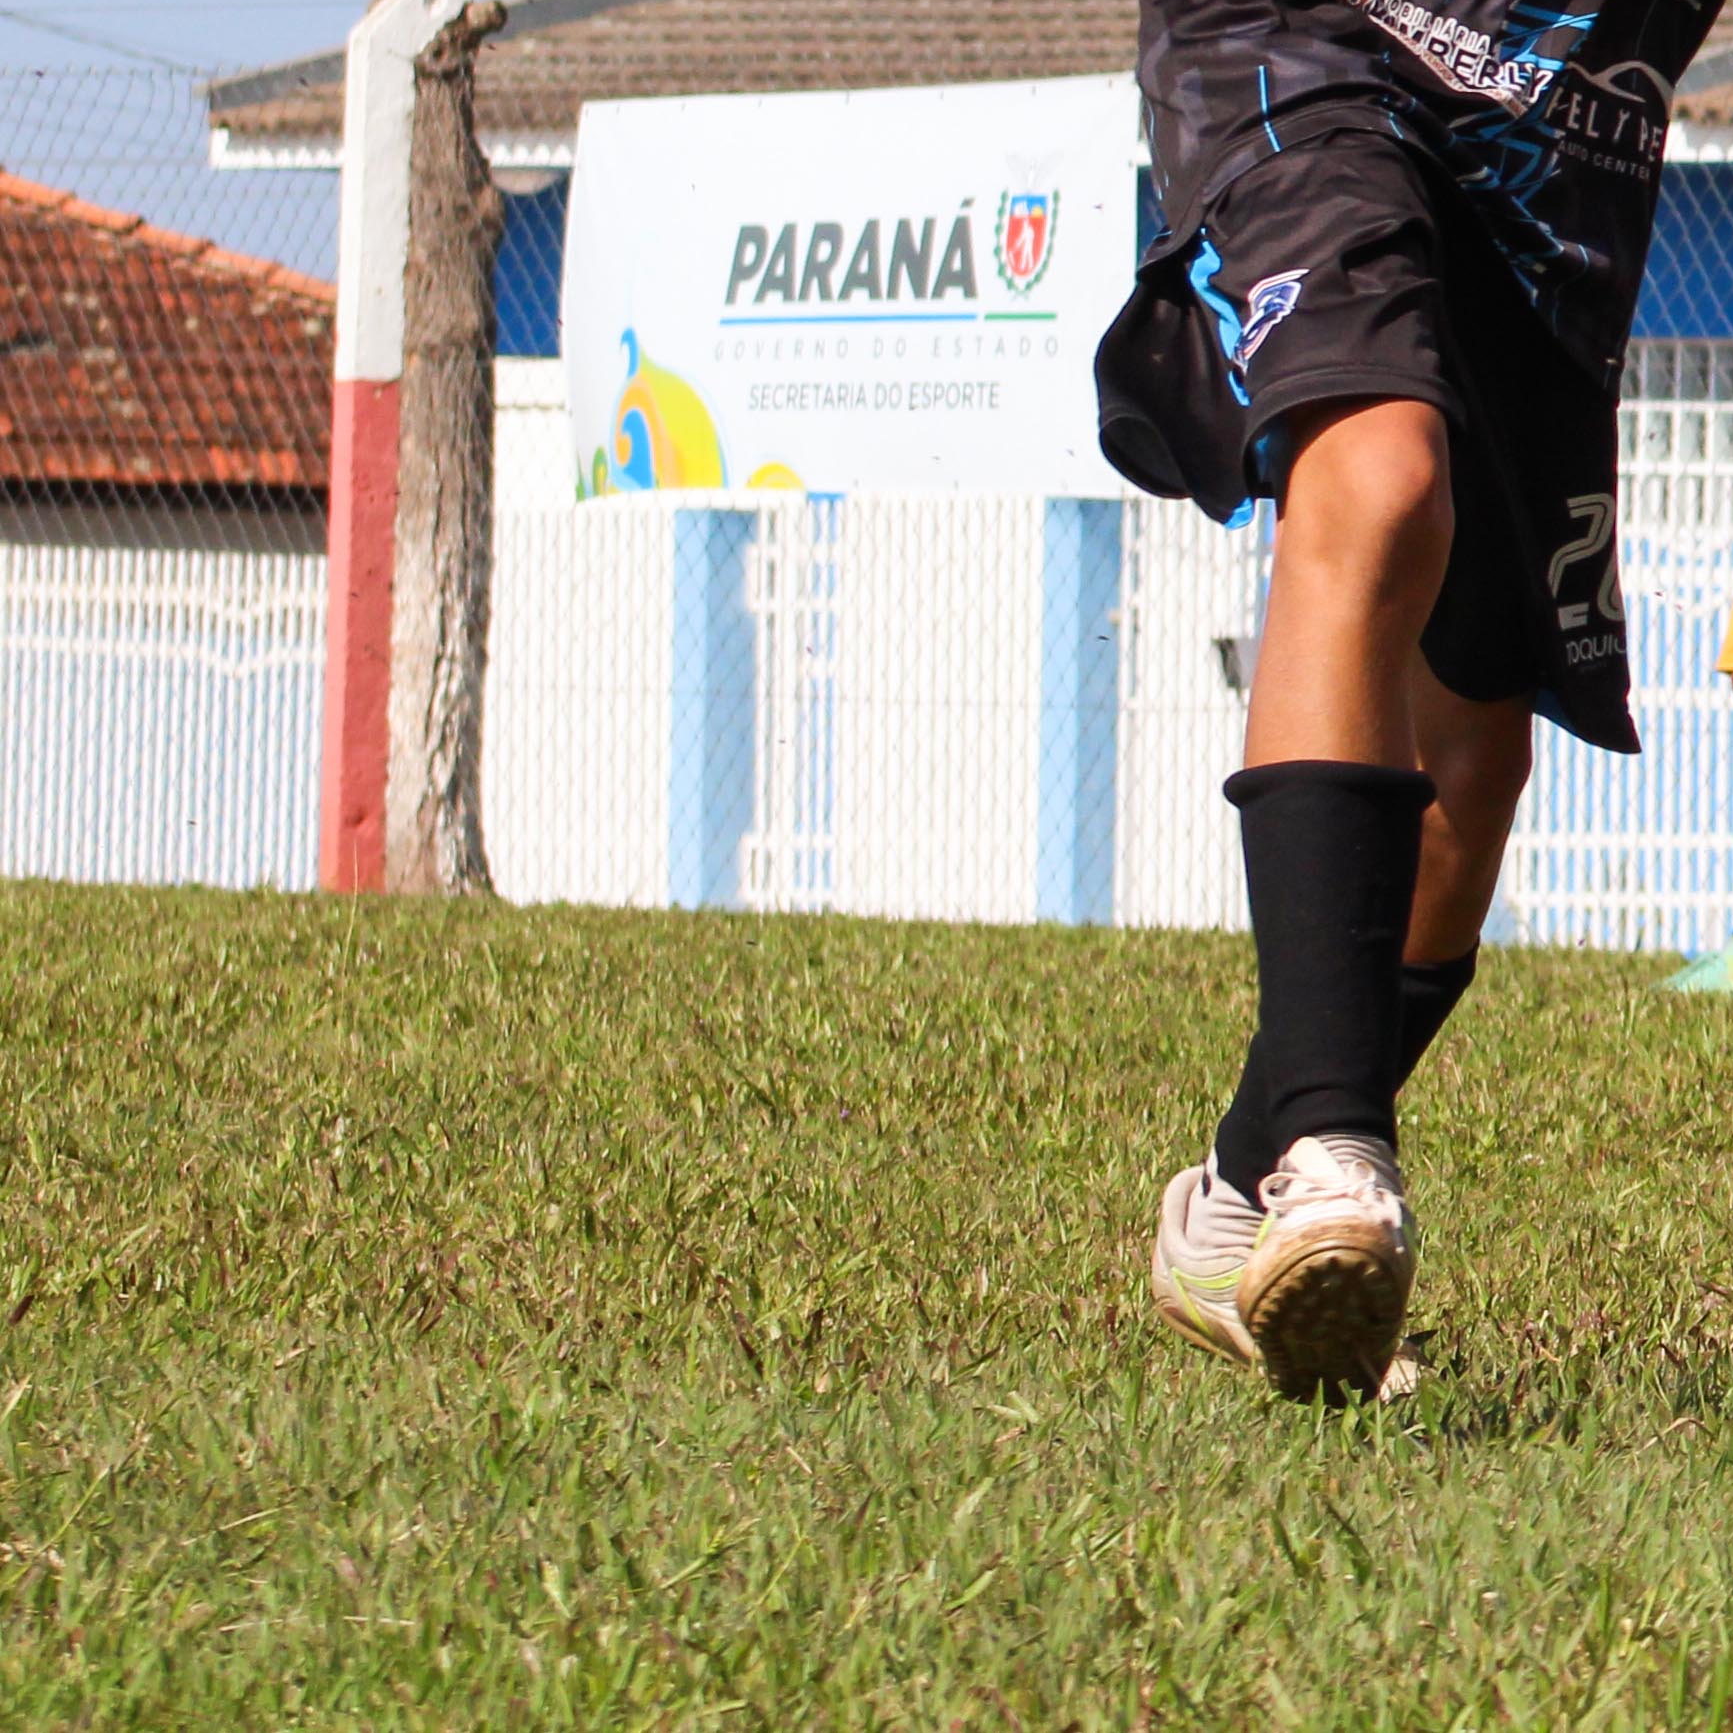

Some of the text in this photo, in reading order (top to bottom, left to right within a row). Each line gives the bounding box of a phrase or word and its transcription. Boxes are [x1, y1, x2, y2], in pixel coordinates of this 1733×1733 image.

[724, 197, 979, 306] PARANÁ
[714, 334, 1059, 363] GOVERNO DO ESTADO
[748, 381, 1001, 411] SECRETARIA DO ESPORTE
